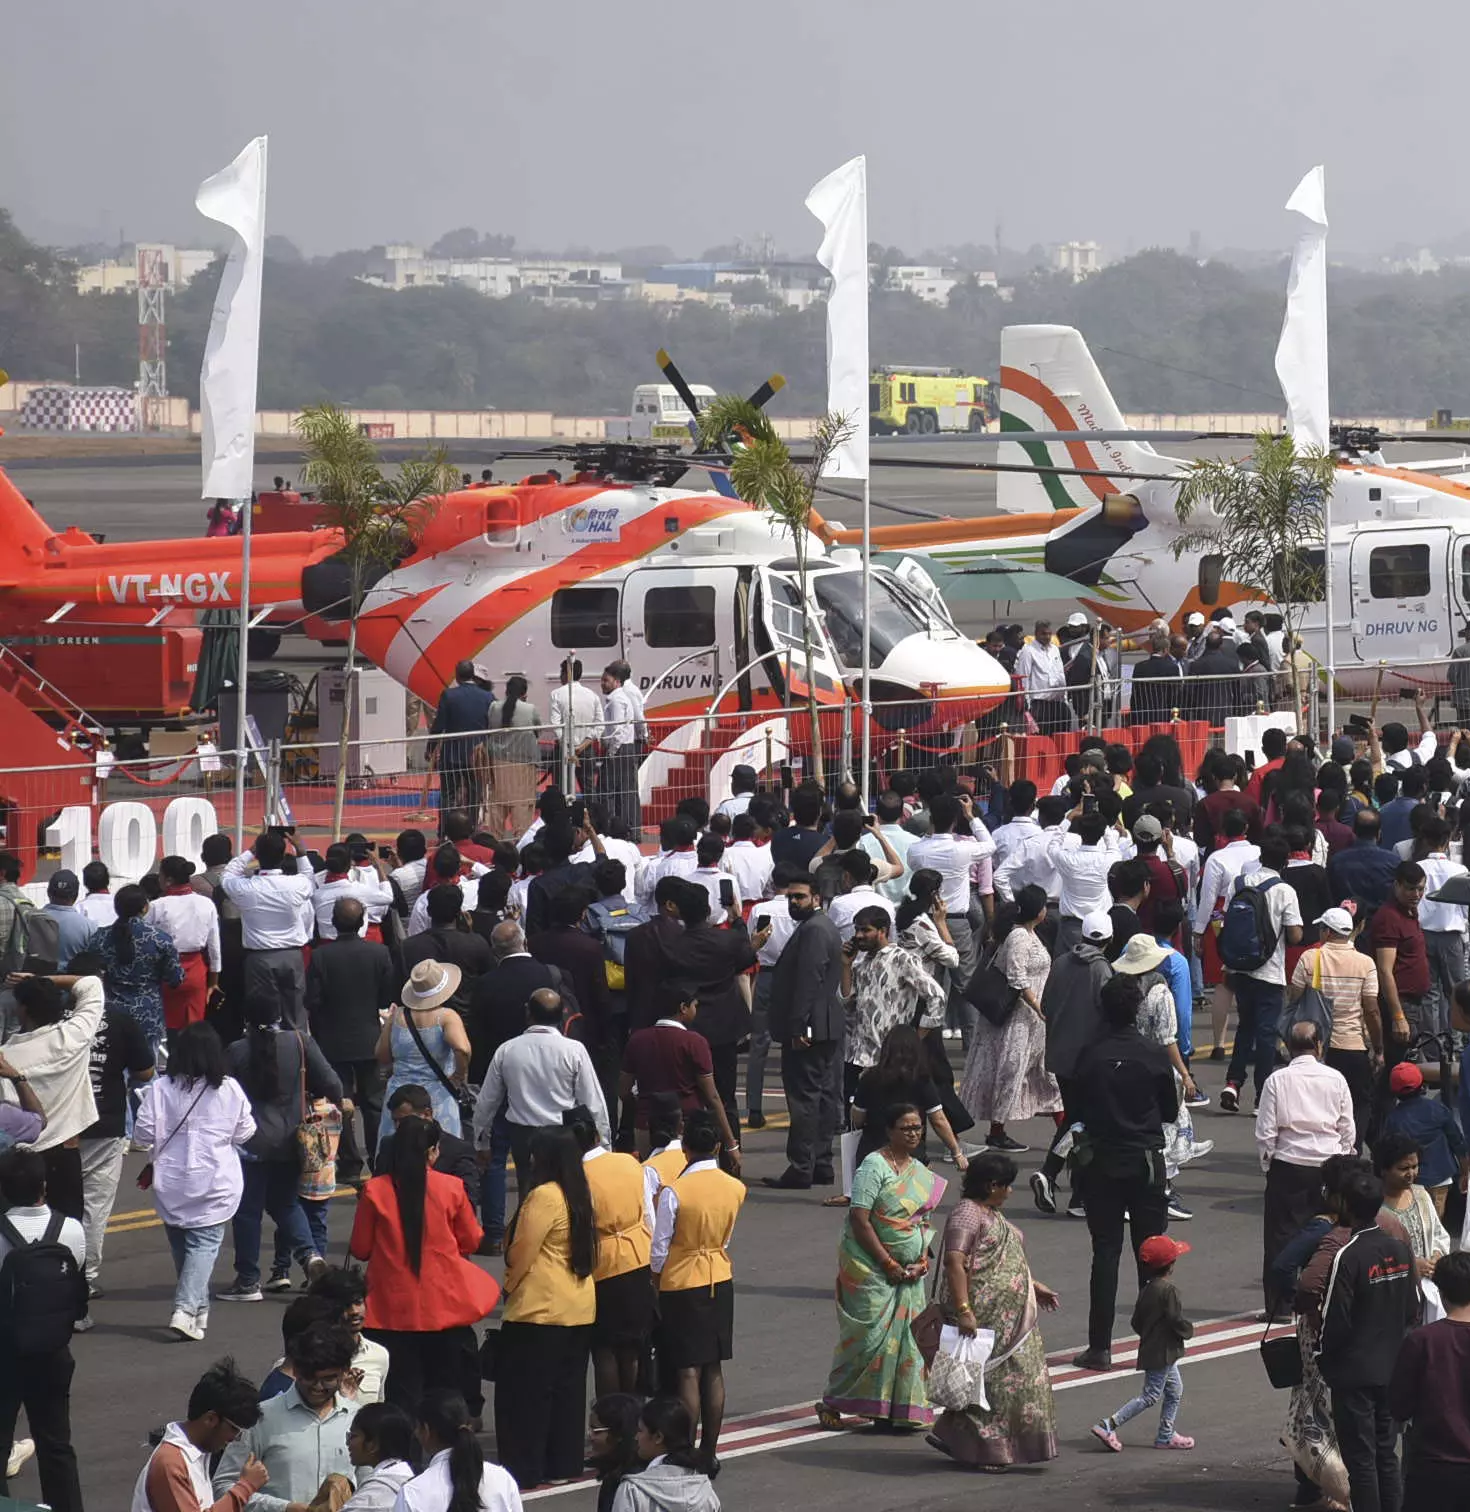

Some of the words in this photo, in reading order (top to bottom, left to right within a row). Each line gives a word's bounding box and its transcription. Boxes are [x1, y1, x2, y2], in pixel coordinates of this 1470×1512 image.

[588, 521, 612, 533] HAL
[108, 571, 232, 604] VT-NGX
[1365, 620, 1415, 636] DHRUV
[1417, 619, 1438, 632] NG
[57, 635, 101, 646] GREEN
[46, 797, 219, 884] 100
